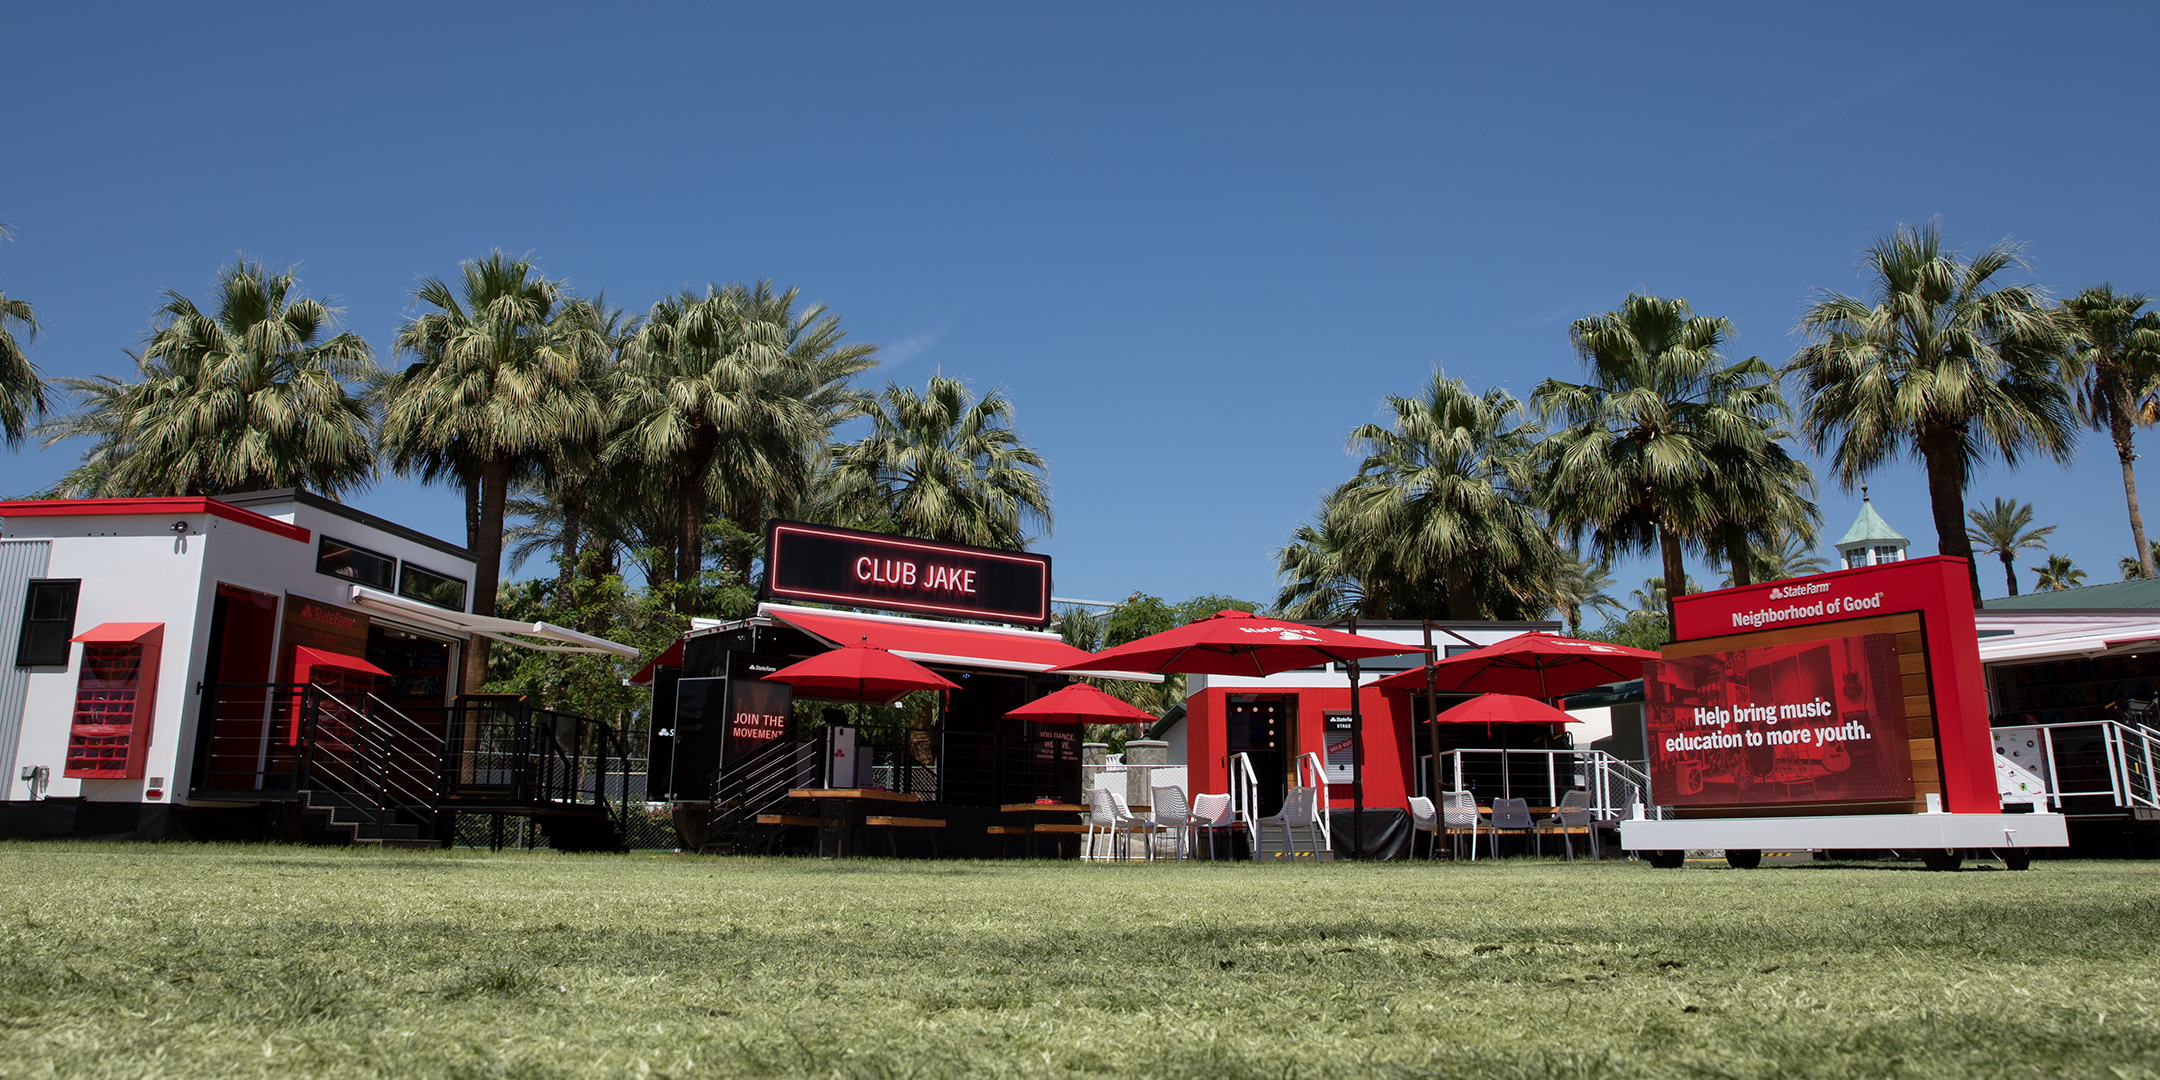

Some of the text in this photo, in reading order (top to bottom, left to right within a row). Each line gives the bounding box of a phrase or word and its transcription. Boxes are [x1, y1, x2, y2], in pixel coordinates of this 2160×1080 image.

[856, 556, 976, 593] CLUB JAKE
[1732, 601, 1823, 628] Neighborhood
[1826, 598, 1841, 615] of
[314, 631, 338, 646] STUDIO
[733, 712, 785, 727] JOIN THE
[1694, 697, 1832, 728] Help bring music
[732, 727, 784, 740] MOVEMENT
[1665, 720, 1871, 752] education to more youth.
[1329, 740, 1352, 752] SOLD OUT
